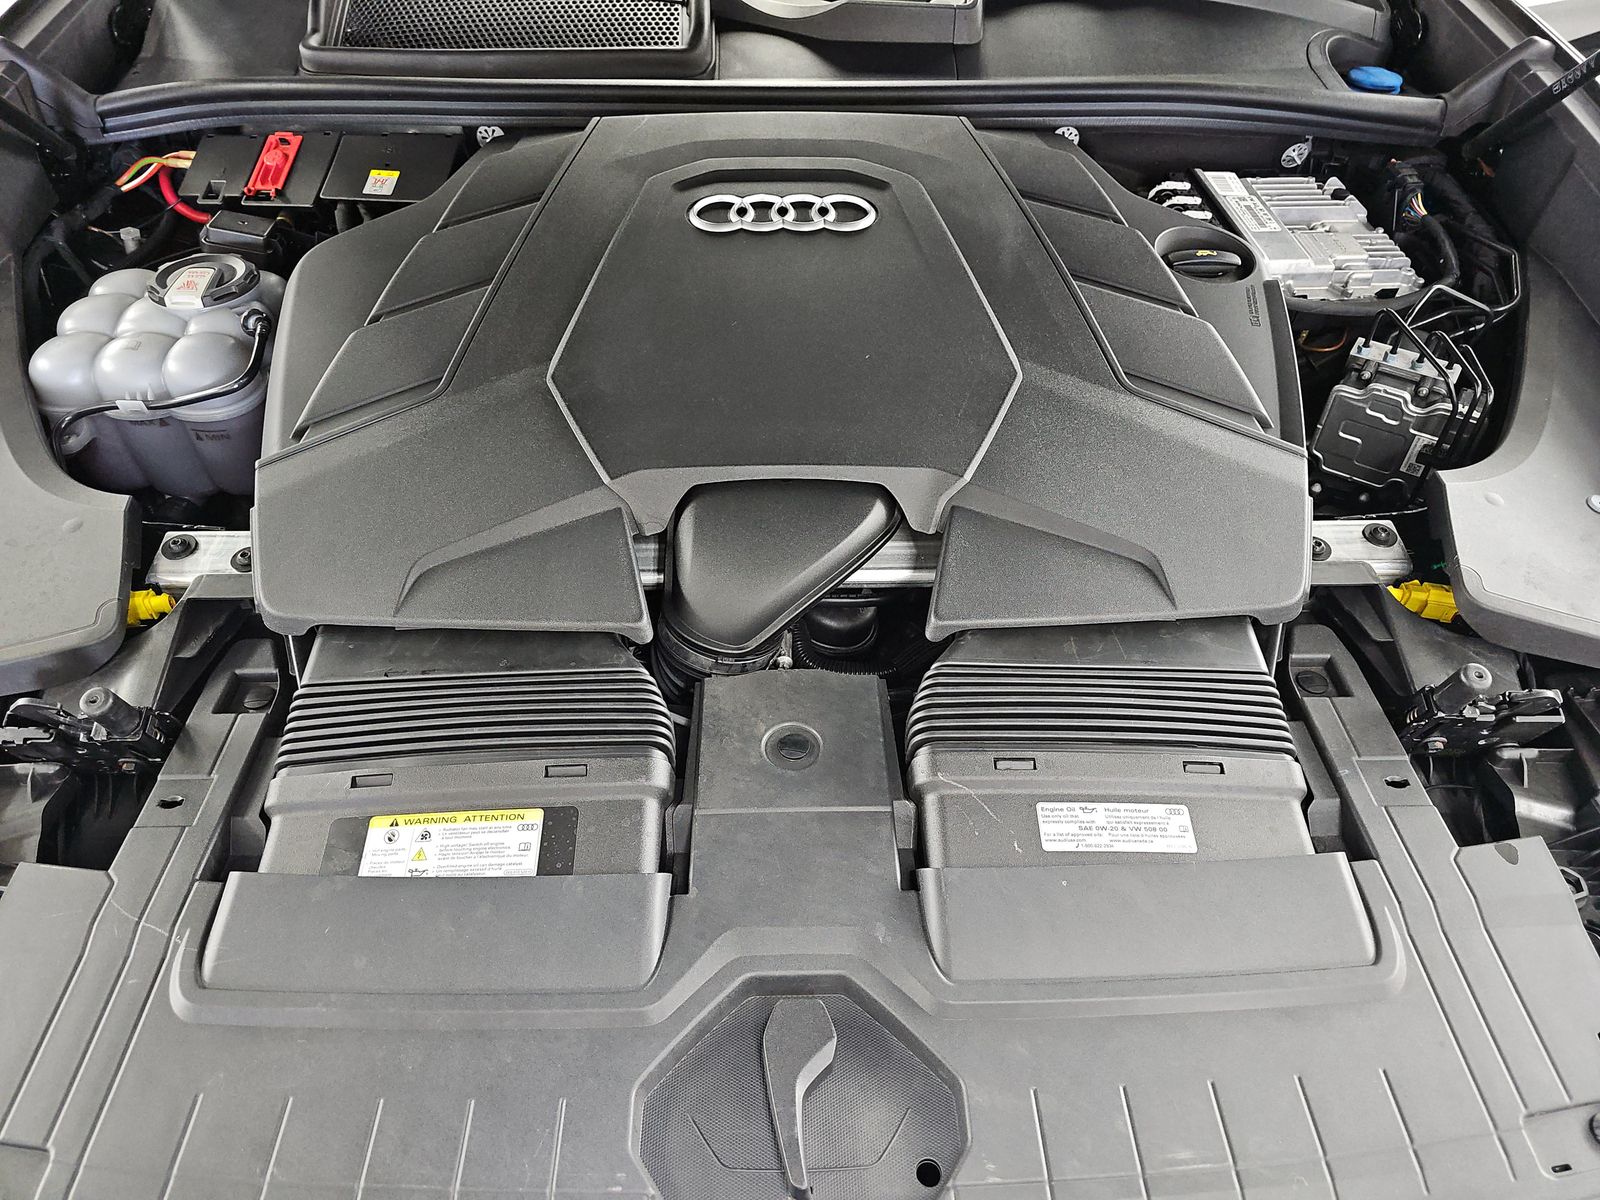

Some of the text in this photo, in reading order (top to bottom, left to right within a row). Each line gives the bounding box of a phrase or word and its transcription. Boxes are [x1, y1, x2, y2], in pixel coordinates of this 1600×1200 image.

[205, 432, 231, 441] MIN
[404, 813, 525, 825] WARNING ATTENTION
